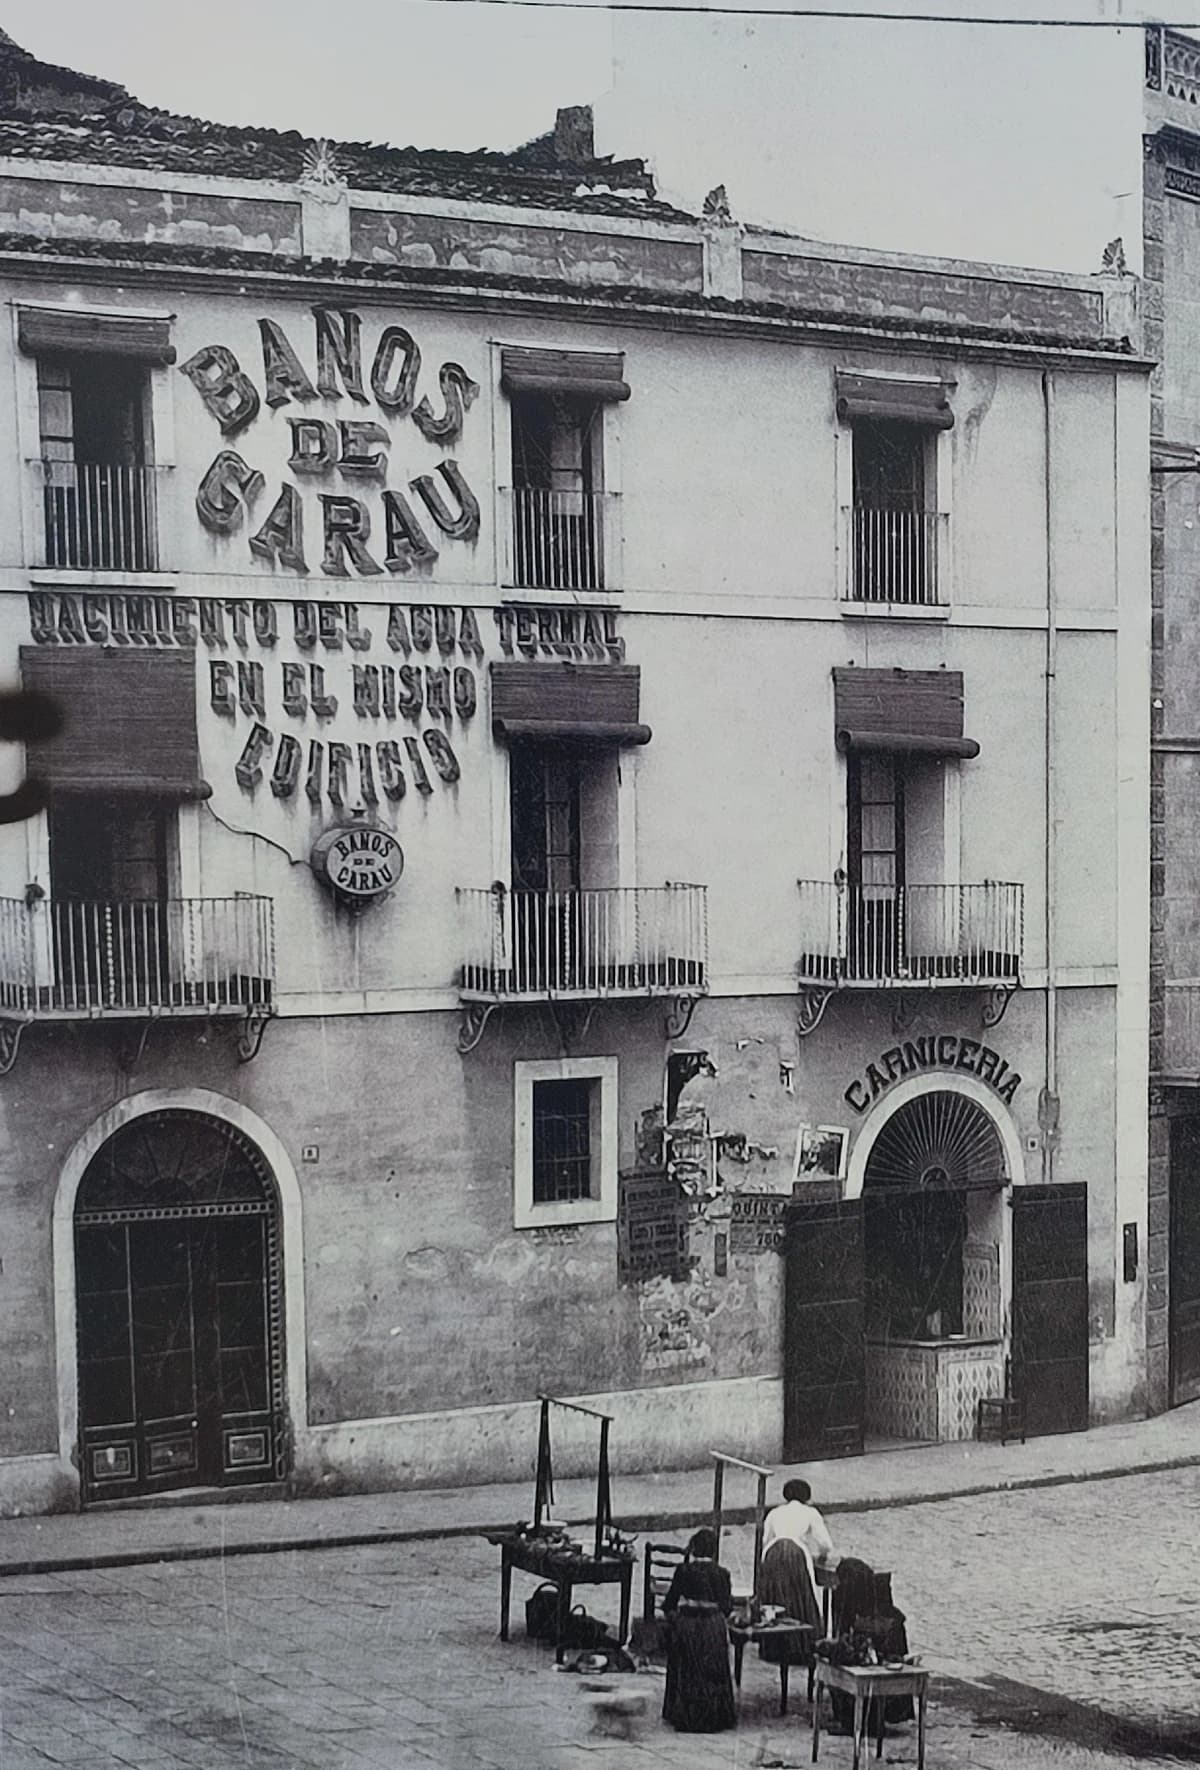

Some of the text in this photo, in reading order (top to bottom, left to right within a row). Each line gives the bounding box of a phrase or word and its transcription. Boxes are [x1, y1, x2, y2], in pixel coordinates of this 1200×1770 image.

[286, 416, 391, 476] DE
[28, 593, 626, 660] NACIMIENTO DEL AGUA TERMAL
[209, 660, 476, 719] EN EL MISMO
[235, 721, 460, 806] EDIFICIO
[353, 858, 375, 866] DE
[844, 1036, 1022, 1112] CARNICERIA
